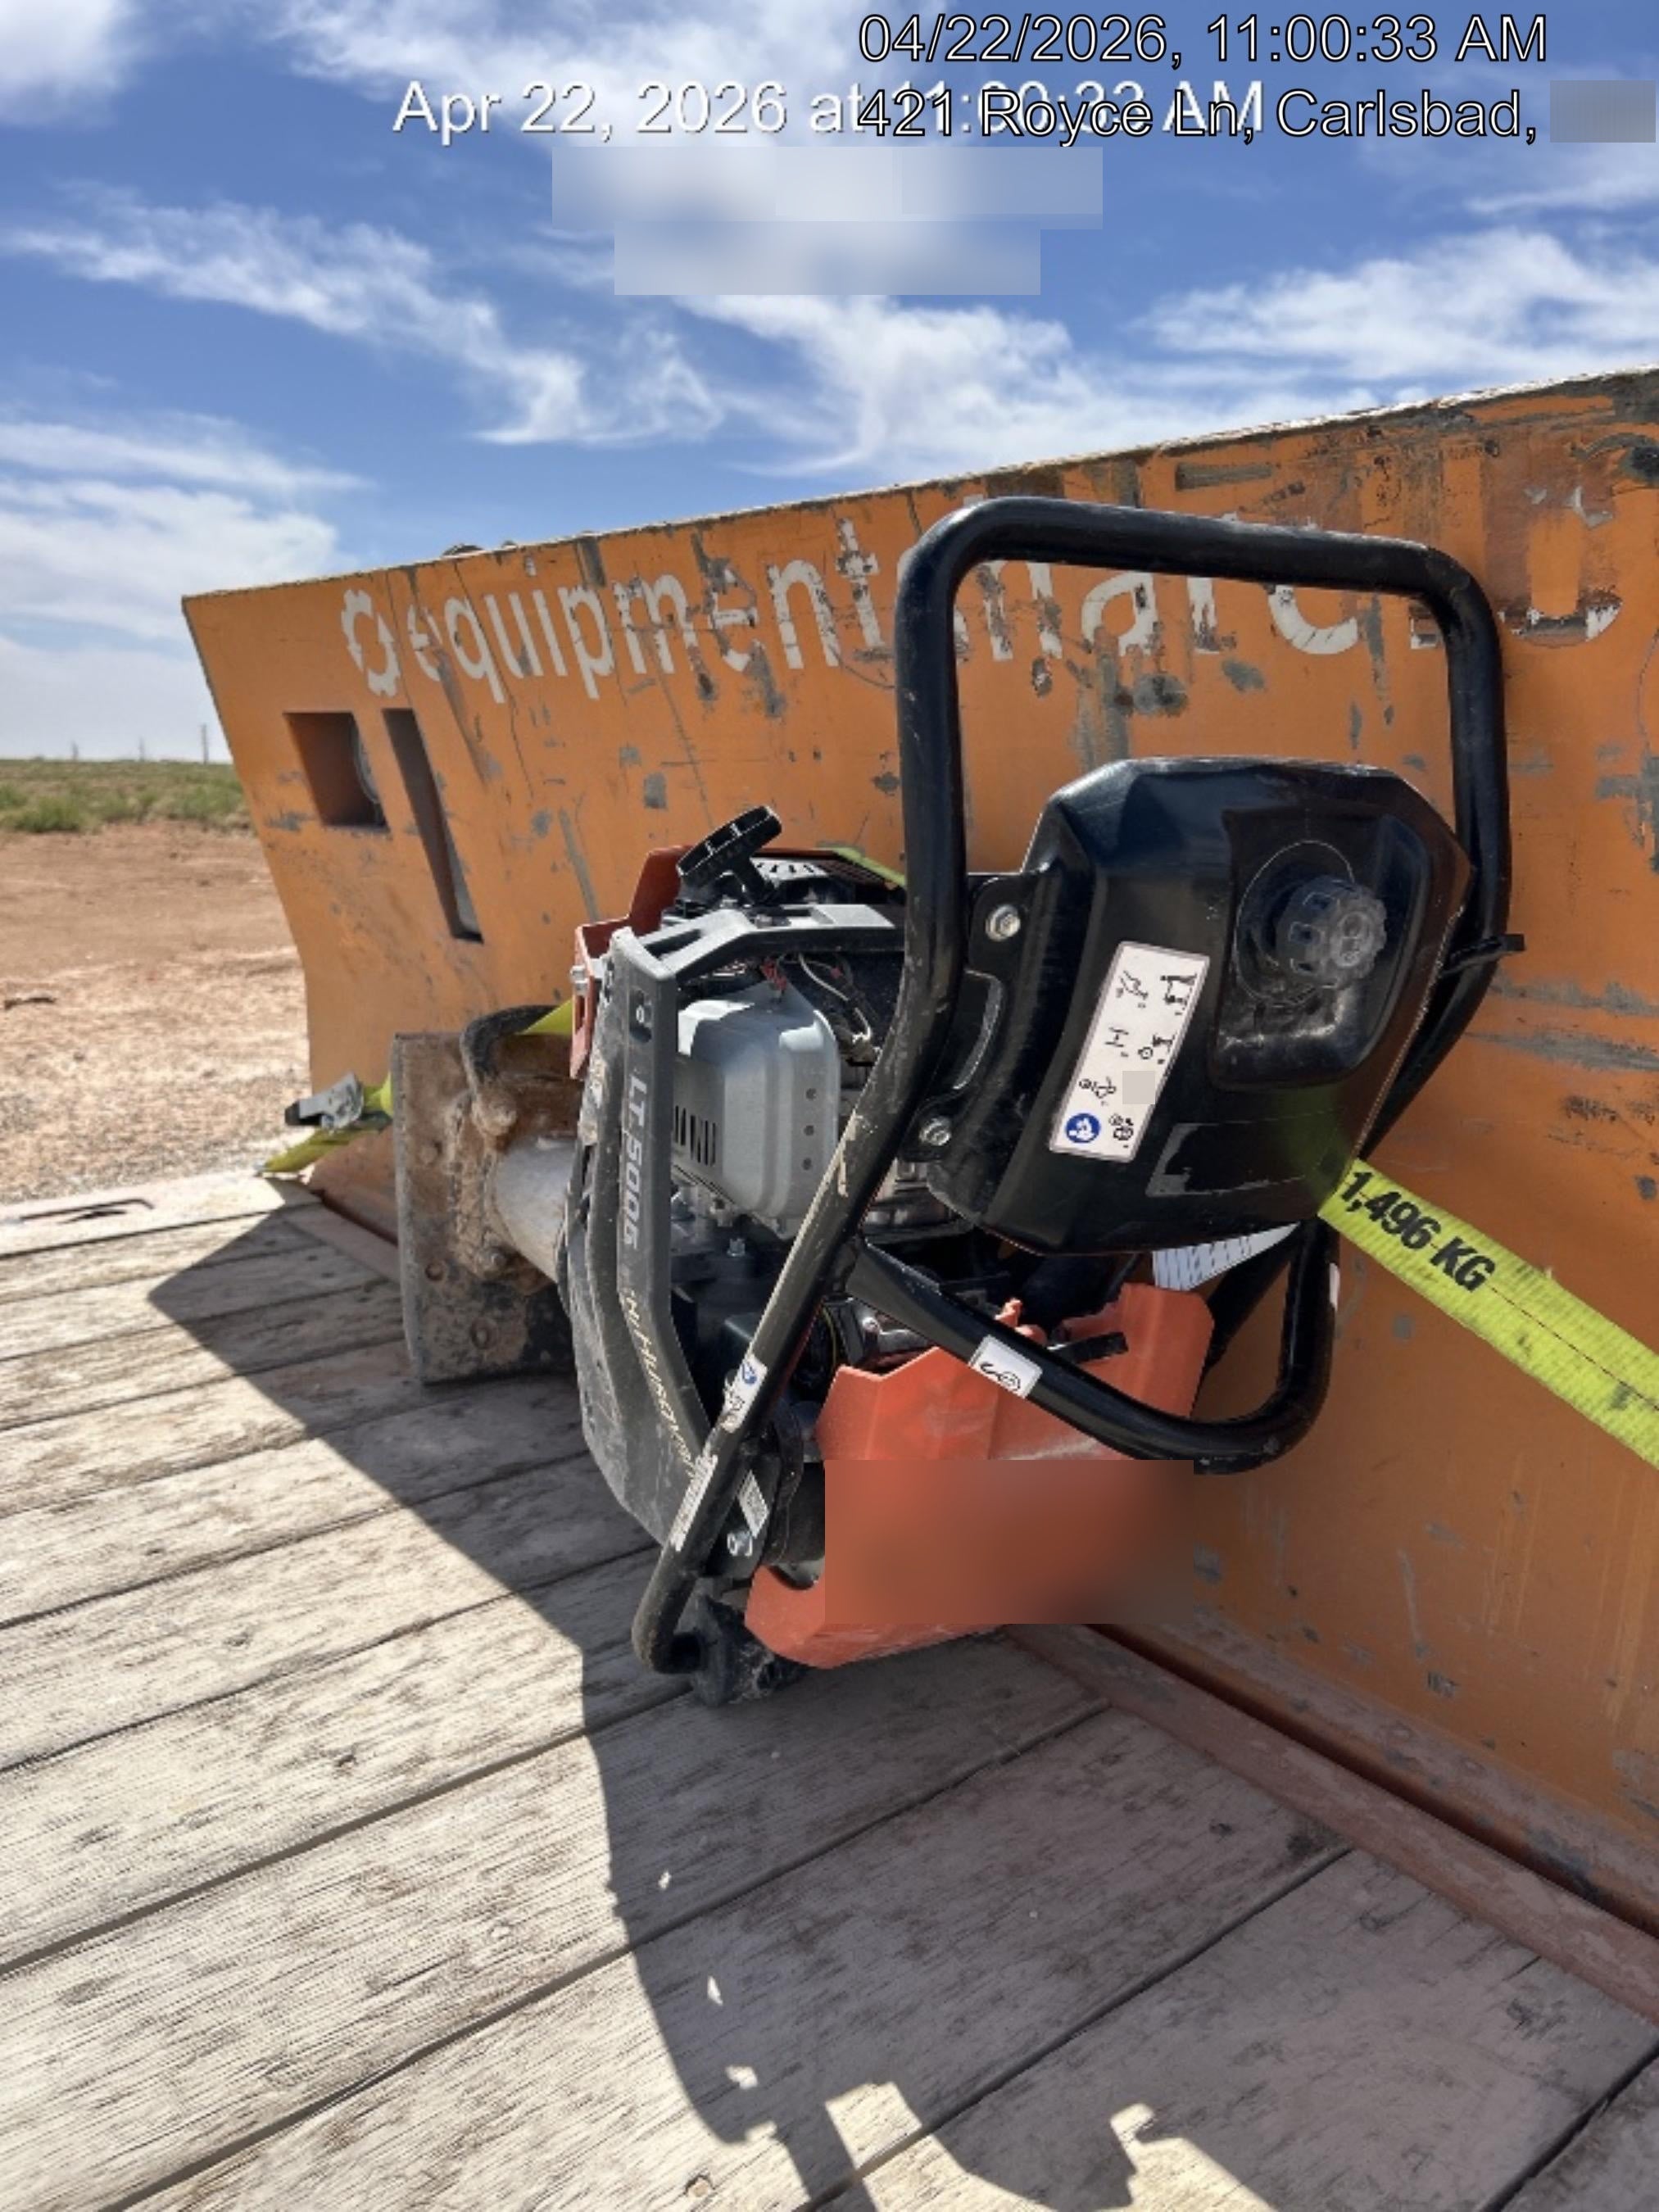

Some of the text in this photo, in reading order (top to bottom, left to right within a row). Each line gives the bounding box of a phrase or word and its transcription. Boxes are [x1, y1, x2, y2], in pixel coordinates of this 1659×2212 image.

[628, 1075, 647, 1127] LT
[1340, 1172, 1497, 1293] 1,496 KG
